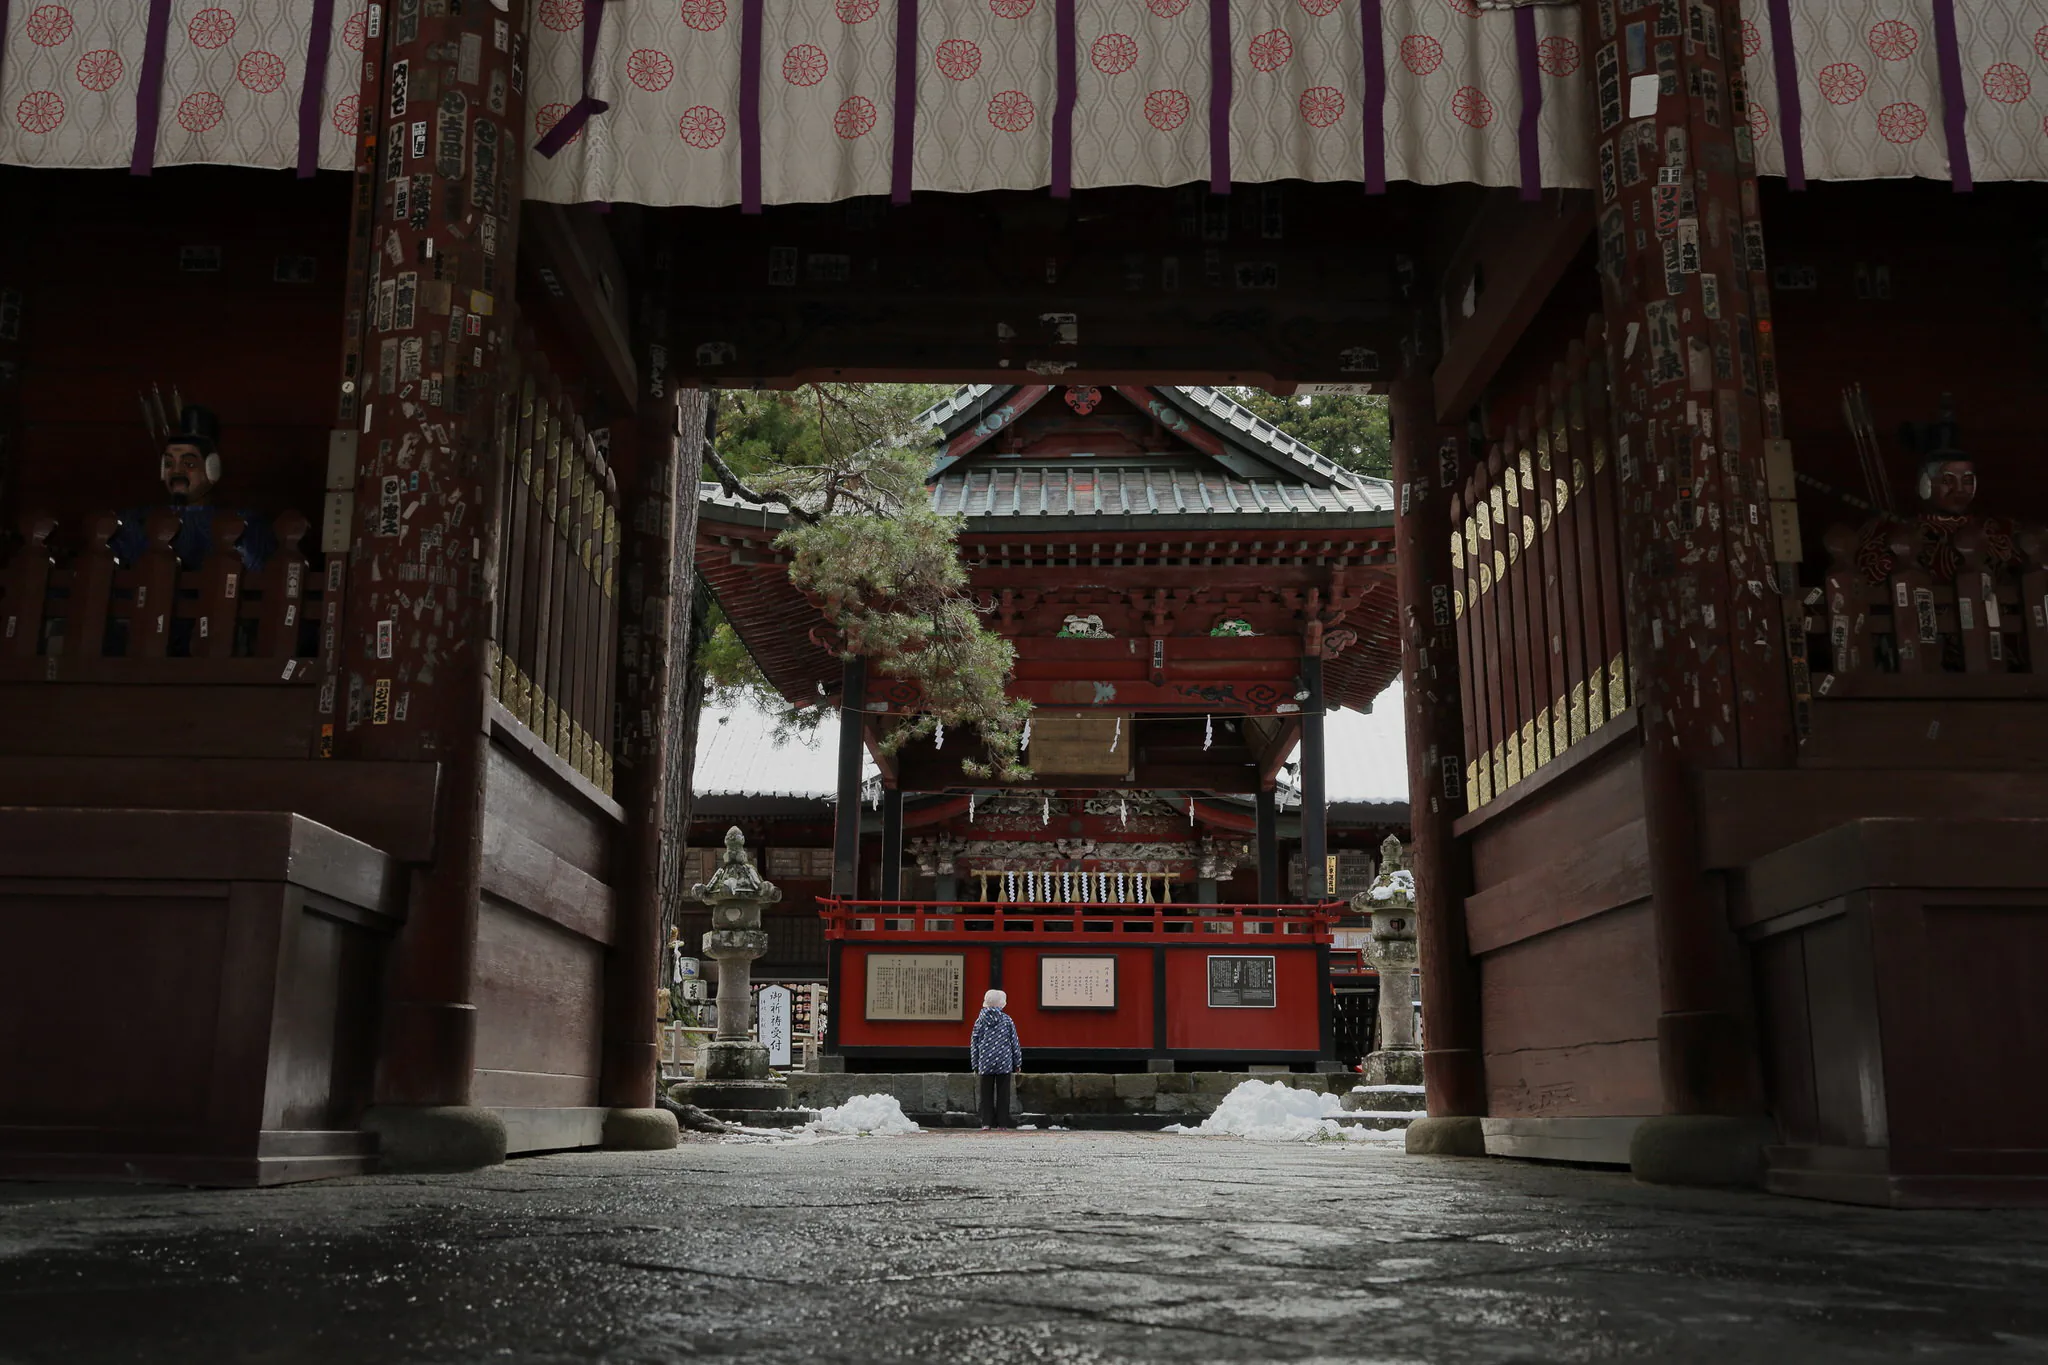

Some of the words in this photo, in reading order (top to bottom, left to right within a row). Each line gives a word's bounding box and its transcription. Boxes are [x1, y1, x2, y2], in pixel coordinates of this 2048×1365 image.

[770, 991, 783, 1052] 御祈祷受付
